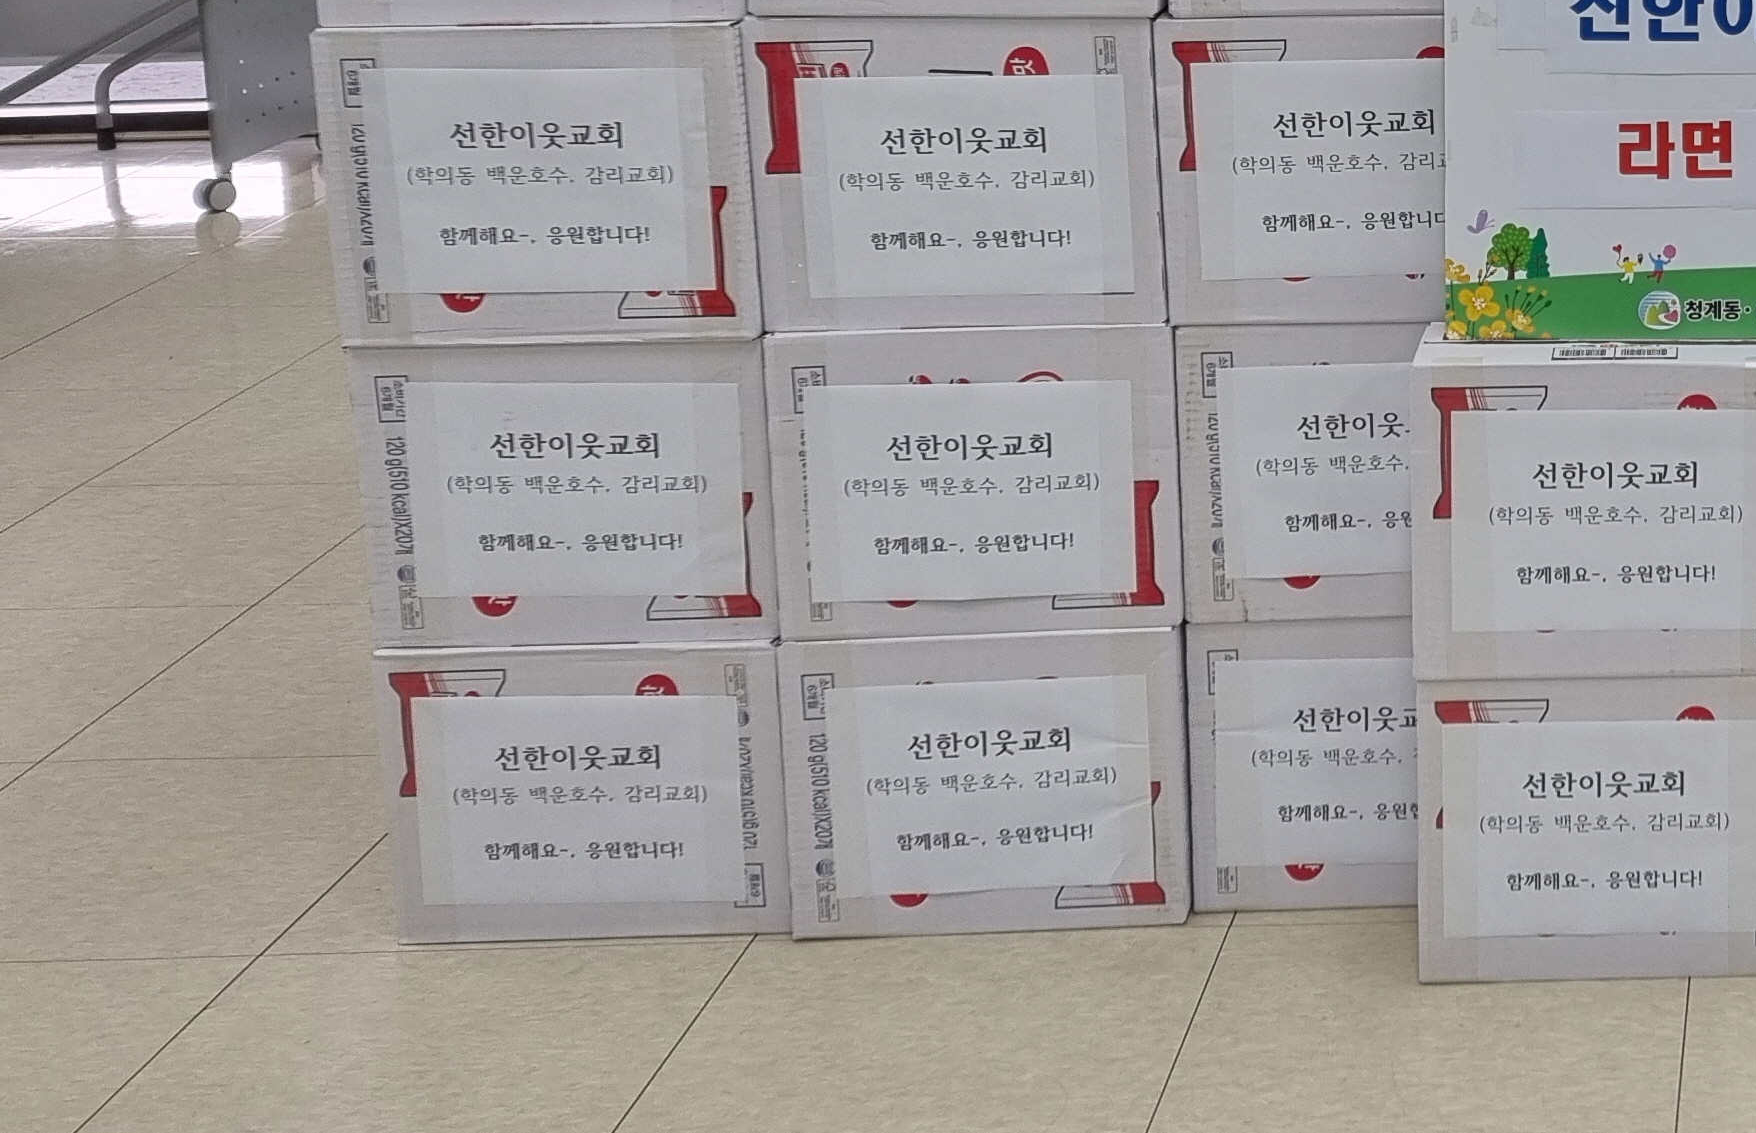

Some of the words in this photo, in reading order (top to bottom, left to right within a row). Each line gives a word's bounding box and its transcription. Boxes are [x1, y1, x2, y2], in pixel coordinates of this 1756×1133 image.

[448, 120, 624, 150] 선한이웃교회
[1272, 108, 1435, 139] 선한이웃교회
[879, 125, 1048, 156] 선한이웃교회
[1617, 119, 1734, 180] 라면
[545, 225, 651, 246] 응원합니다!
[971, 228, 1072, 250] 응원합니다!
[489, 431, 660, 460] 선한이웃교회
[885, 431, 1053, 462] 선한이웃교회
[1531, 460, 1698, 490] 선한이웃교회
[580, 532, 684, 553] 응원합니다!
[973, 531, 1075, 555] 응원합니다!
[1616, 563, 1716, 585] 응원합니다!
[906, 725, 1072, 761] 선한이웃교회
[493, 743, 662, 773] 선한이웃교회
[1522, 769, 1685, 800] 선한이웃교회
[995, 822, 1094, 847] 응원합니다!
[584, 840, 685, 861] 응원합니다!
[1605, 868, 1703, 891] 응원합니다!
